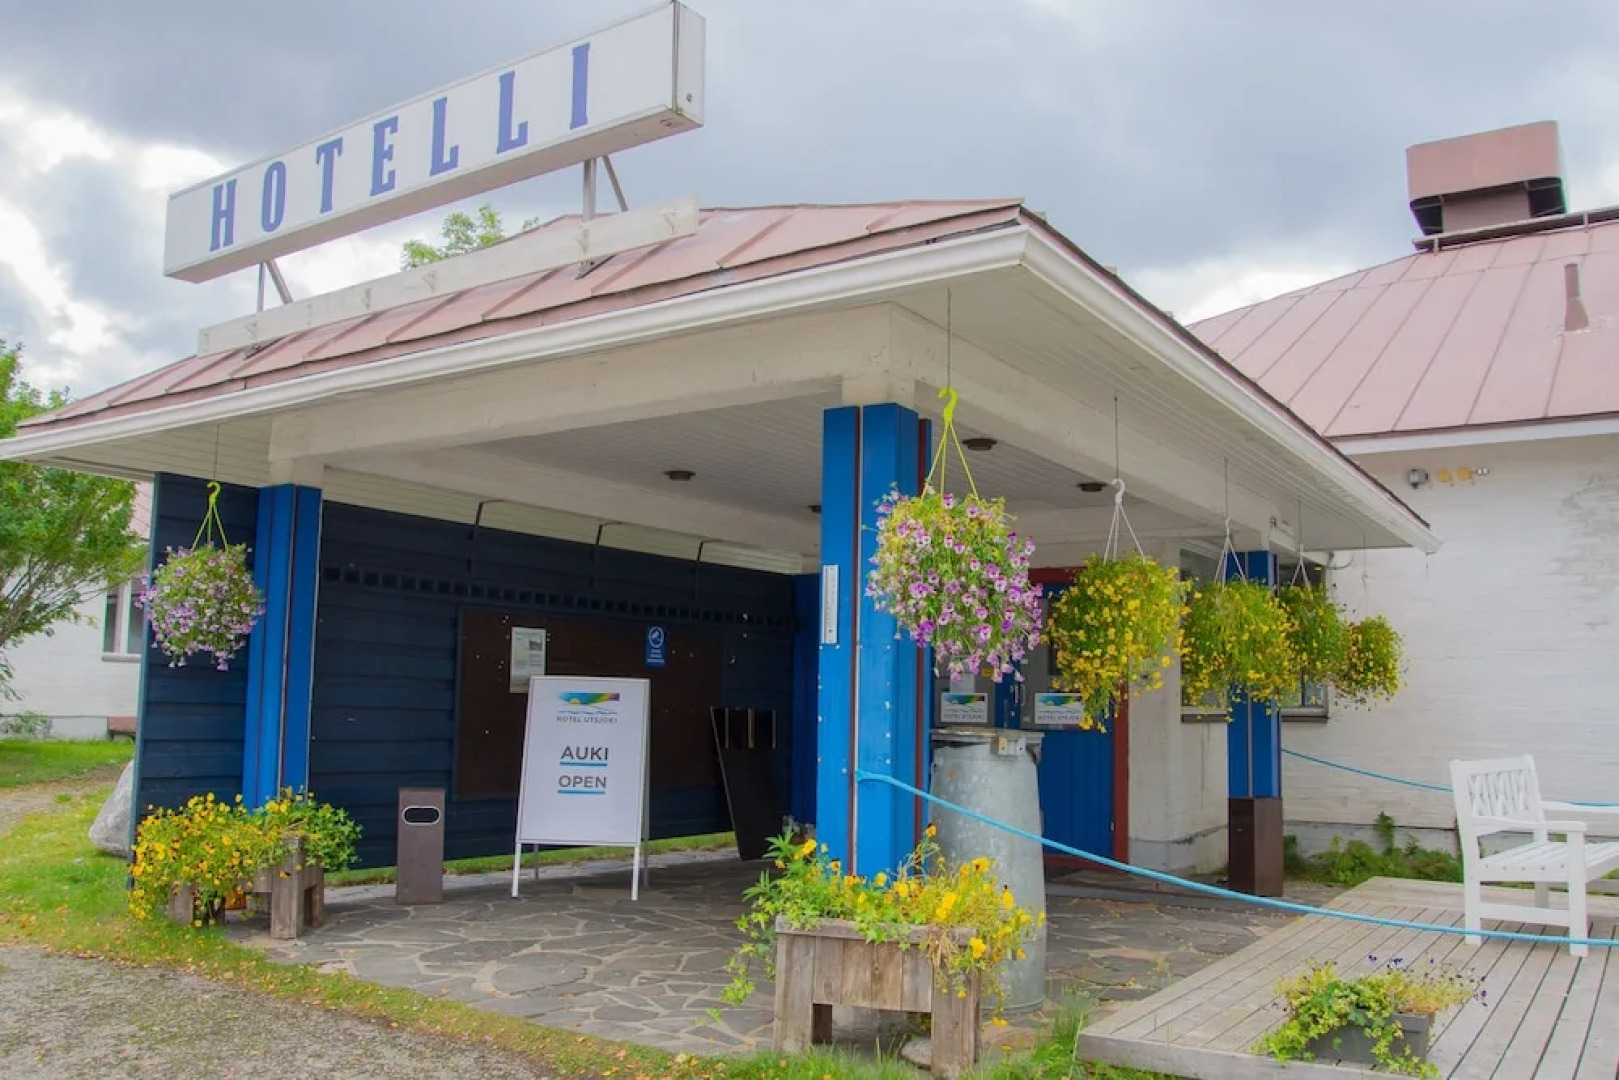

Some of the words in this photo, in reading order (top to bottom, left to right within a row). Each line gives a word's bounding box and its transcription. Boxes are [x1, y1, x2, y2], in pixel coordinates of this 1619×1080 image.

[210, 42, 591, 252] HOTELLI
[556, 715, 581, 723] HOTEL
[584, 716, 618, 724] UTSJOKI
[561, 746, 609, 761] AUKI
[558, 775, 607, 789] OPEN
